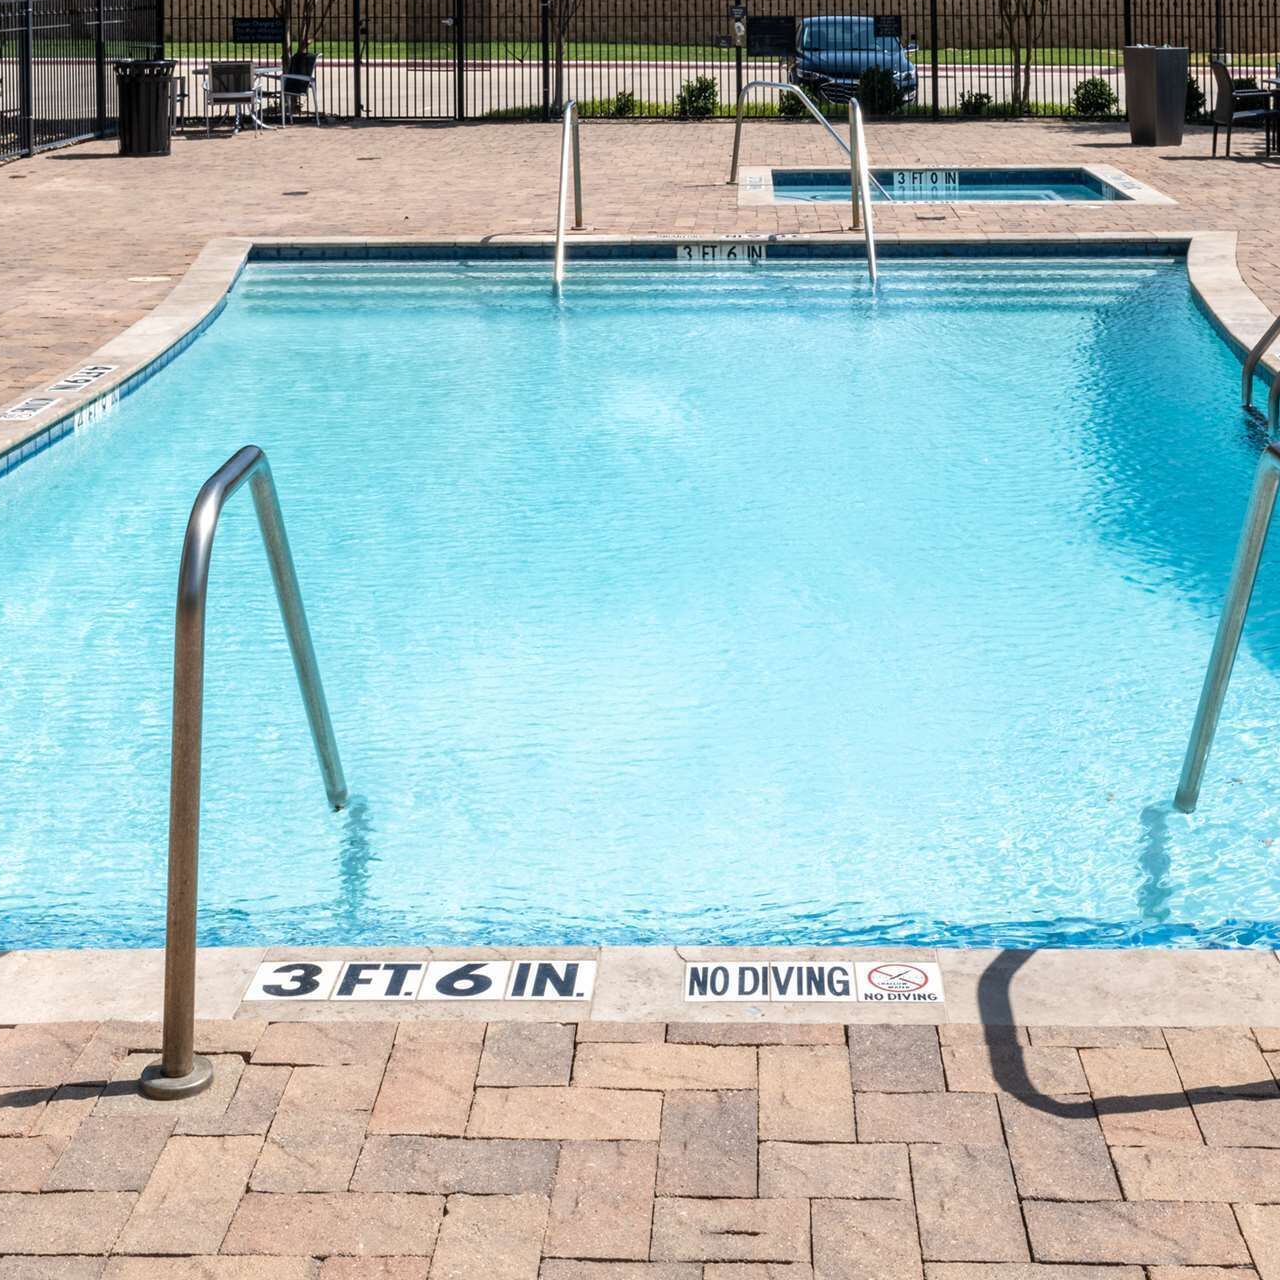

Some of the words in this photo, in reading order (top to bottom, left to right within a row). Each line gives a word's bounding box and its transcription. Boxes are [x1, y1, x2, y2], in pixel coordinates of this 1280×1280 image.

[898, 172, 905, 184] 3
[912, 172, 924, 184] FT
[931, 172, 938, 184] 0
[945, 172, 957, 184] IN
[683, 245, 693, 260] 3
[702, 245, 718, 260] FT
[747, 244, 762, 260] IN
[262, 963, 323, 997] 3
[336, 963, 423, 997] FT.
[435, 963, 493, 997] 6
[511, 963, 585, 997] IN.
[688, 966, 730, 996] NO
[738, 966, 851, 996] DIVING
[864, 992, 885, 1001] NO
[887, 992, 939, 1001] DIVING
